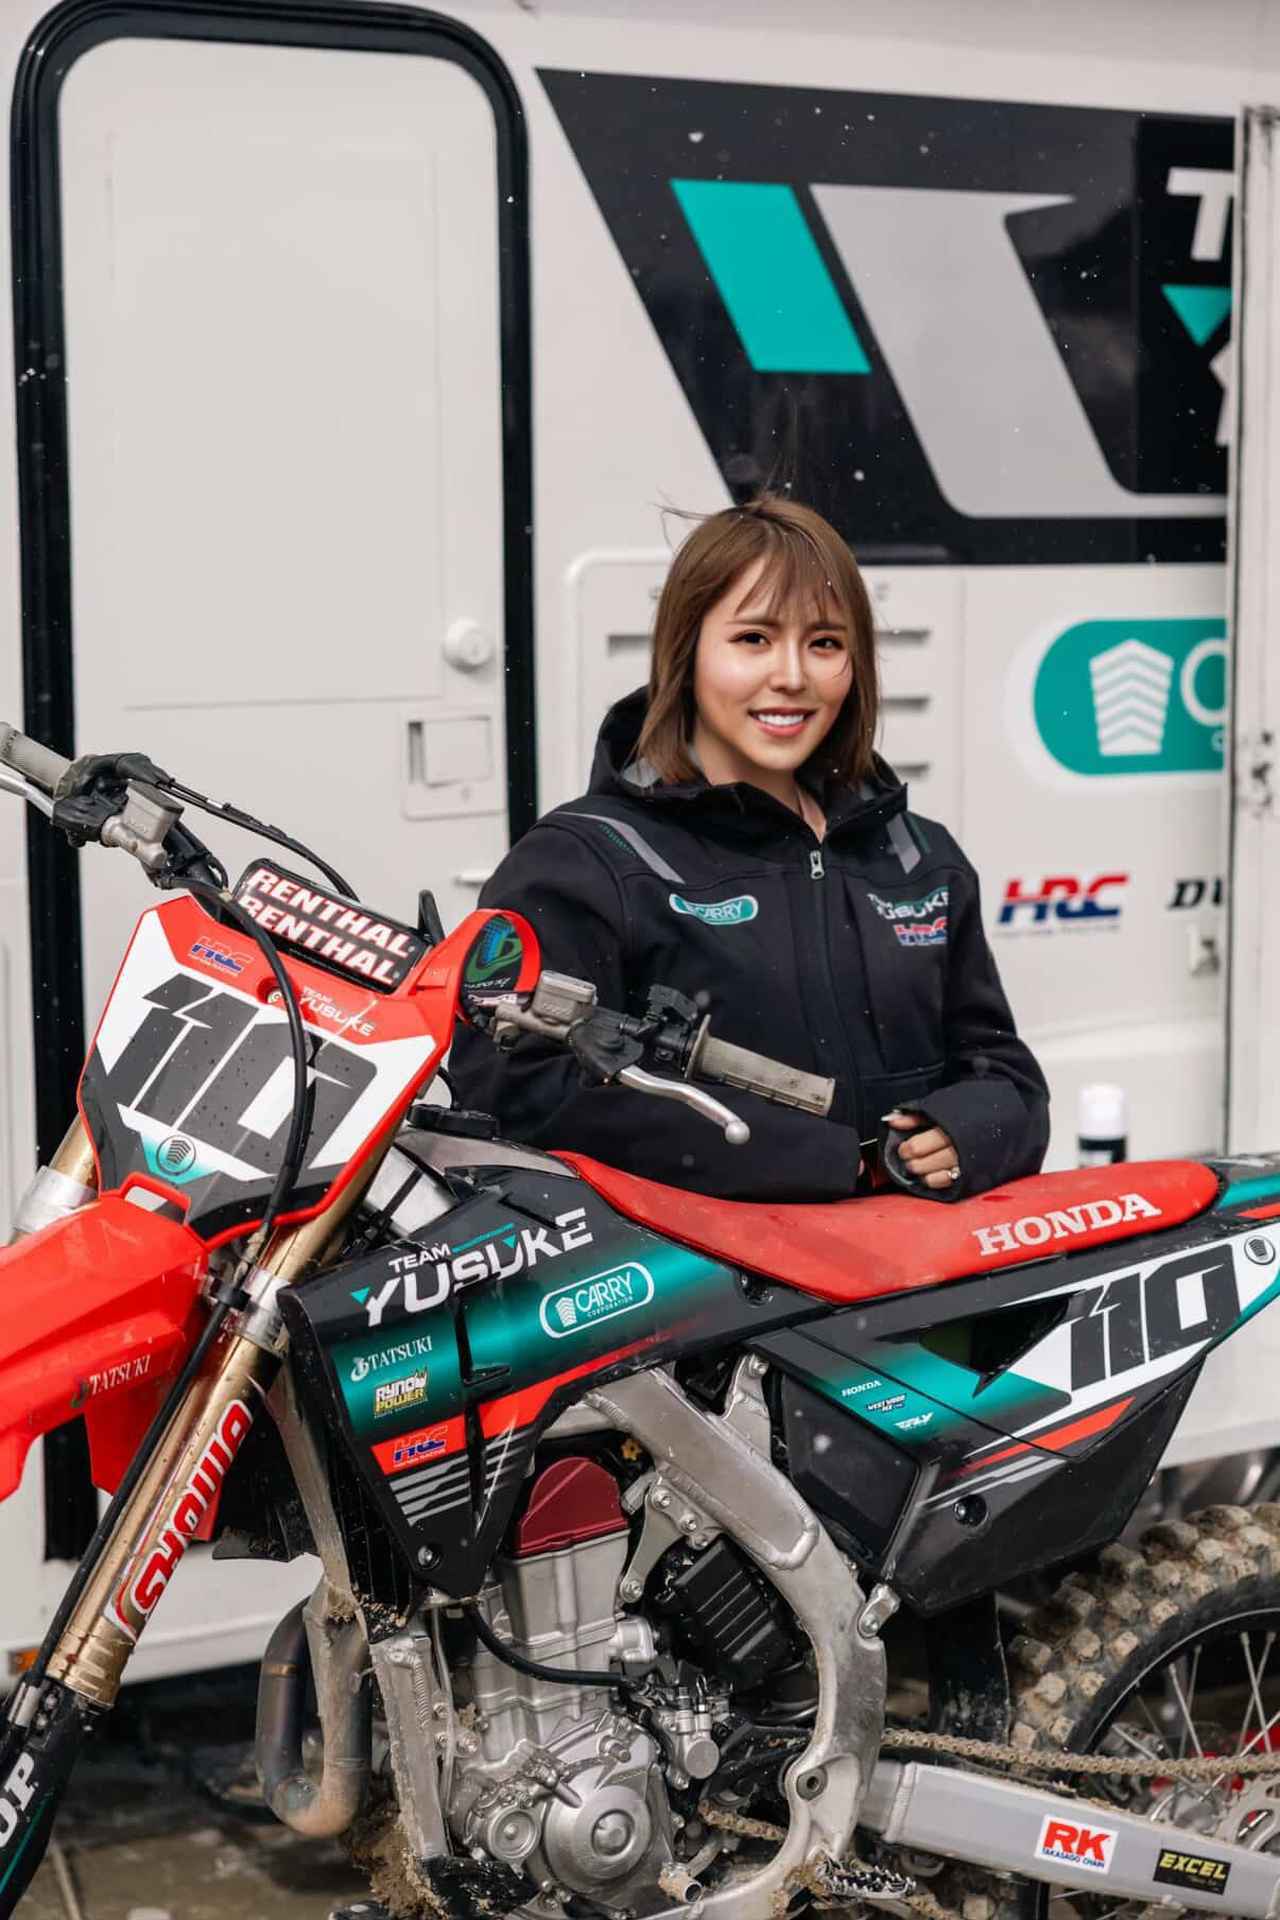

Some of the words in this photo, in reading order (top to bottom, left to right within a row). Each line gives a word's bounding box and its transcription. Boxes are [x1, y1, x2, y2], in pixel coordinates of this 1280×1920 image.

[248, 867, 410, 958] RENTHAL
[998, 871, 1128, 924] HRC
[236, 894, 398, 986] RENTHAL
[299, 995, 376, 1037] YUSUKE
[97, 972, 377, 1179] 110
[972, 1192, 1163, 1257] HONDA
[365, 1207, 594, 1328] YUSUKE
[388, 1243, 452, 1274] TEAM
[575, 1271, 633, 1313] CARRY
[1063, 1243, 1242, 1392] 110
[367, 1335, 433, 1371] TATSUKI
[89, 1353, 151, 1396] TATSUKI
[841, 1379, 883, 1398] HONDA
[374, 1388, 425, 1414] POWER
[393, 1424, 448, 1464] HRC
[1043, 1821, 1111, 1862] RK
[1159, 1852, 1227, 1880] EXCEL
